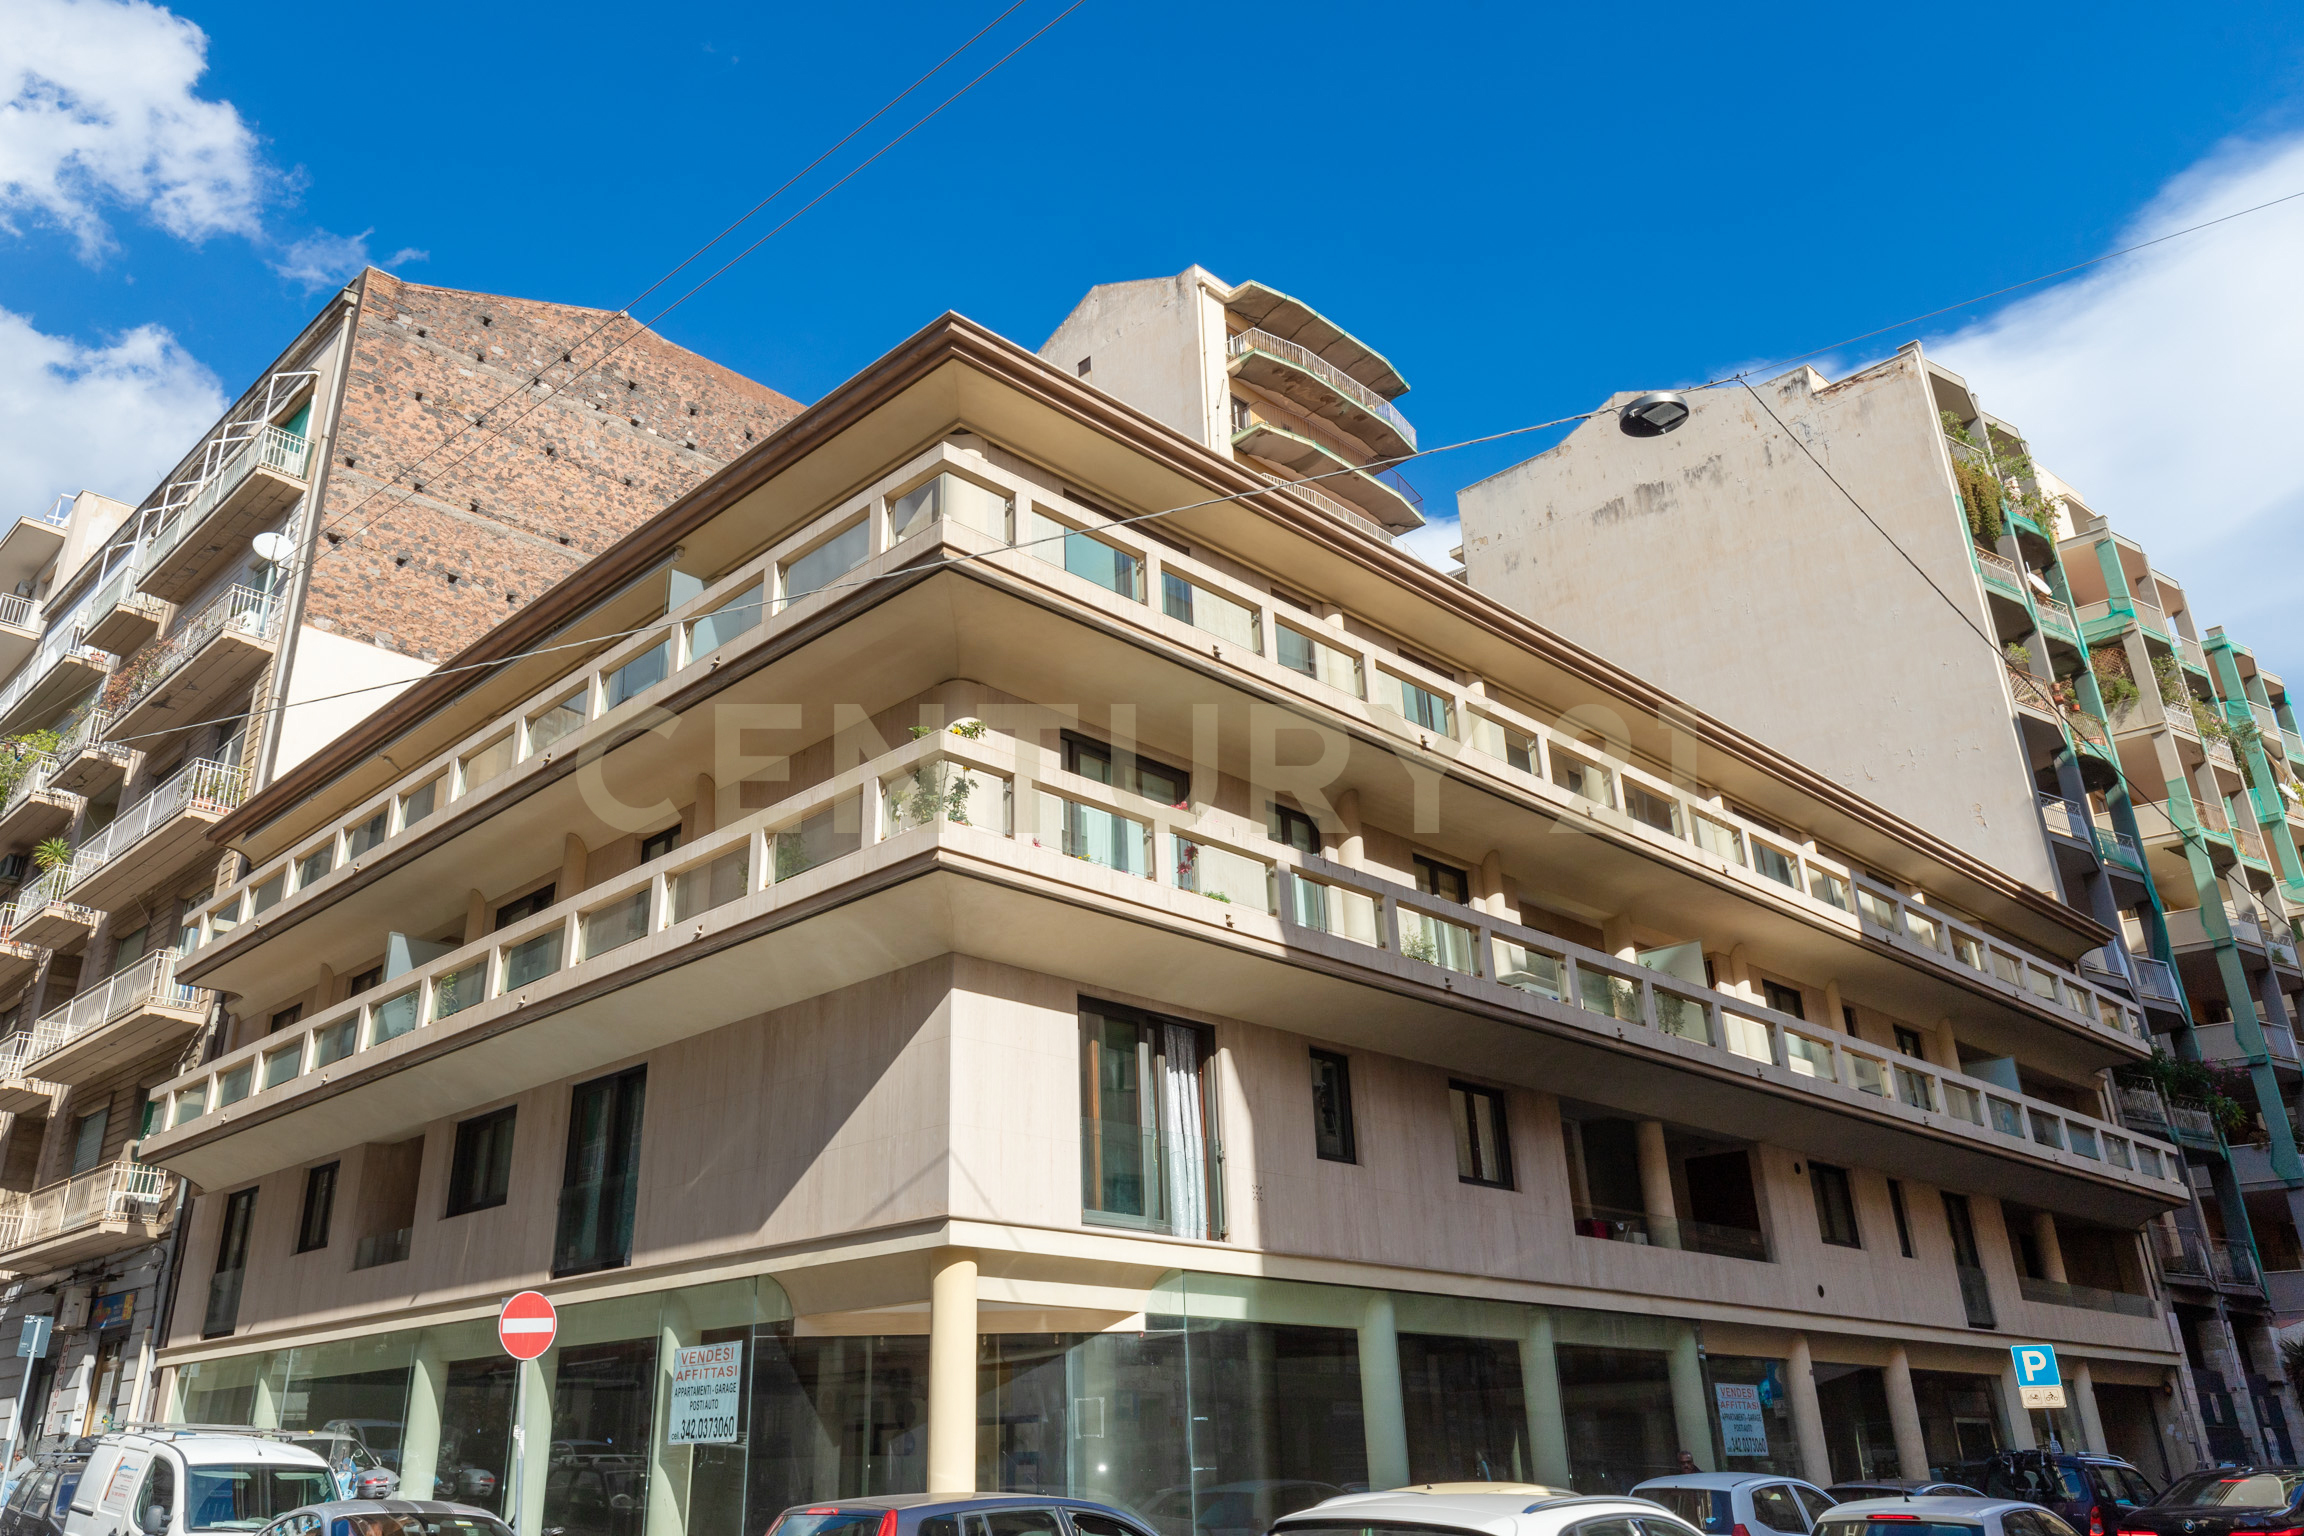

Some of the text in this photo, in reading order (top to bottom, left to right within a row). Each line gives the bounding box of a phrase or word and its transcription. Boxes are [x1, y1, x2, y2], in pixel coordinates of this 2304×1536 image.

[681, 1347, 735, 1365] VENDESI
[675, 1365, 738, 1382] AFFITTASI
[2021, 1350, 2047, 1382] P
[46, 1334, 72, 1434] FOTOCOPIE
[674, 1385, 712, 1397] APPARTAMENTI
[715, 1382, 737, 1394] GARAGE
[1720, 1387, 1755, 1399] VENDESI
[1720, 1400, 1760, 1410] AFFITTASI
[680, 1416, 735, 1440] 342.0373060
